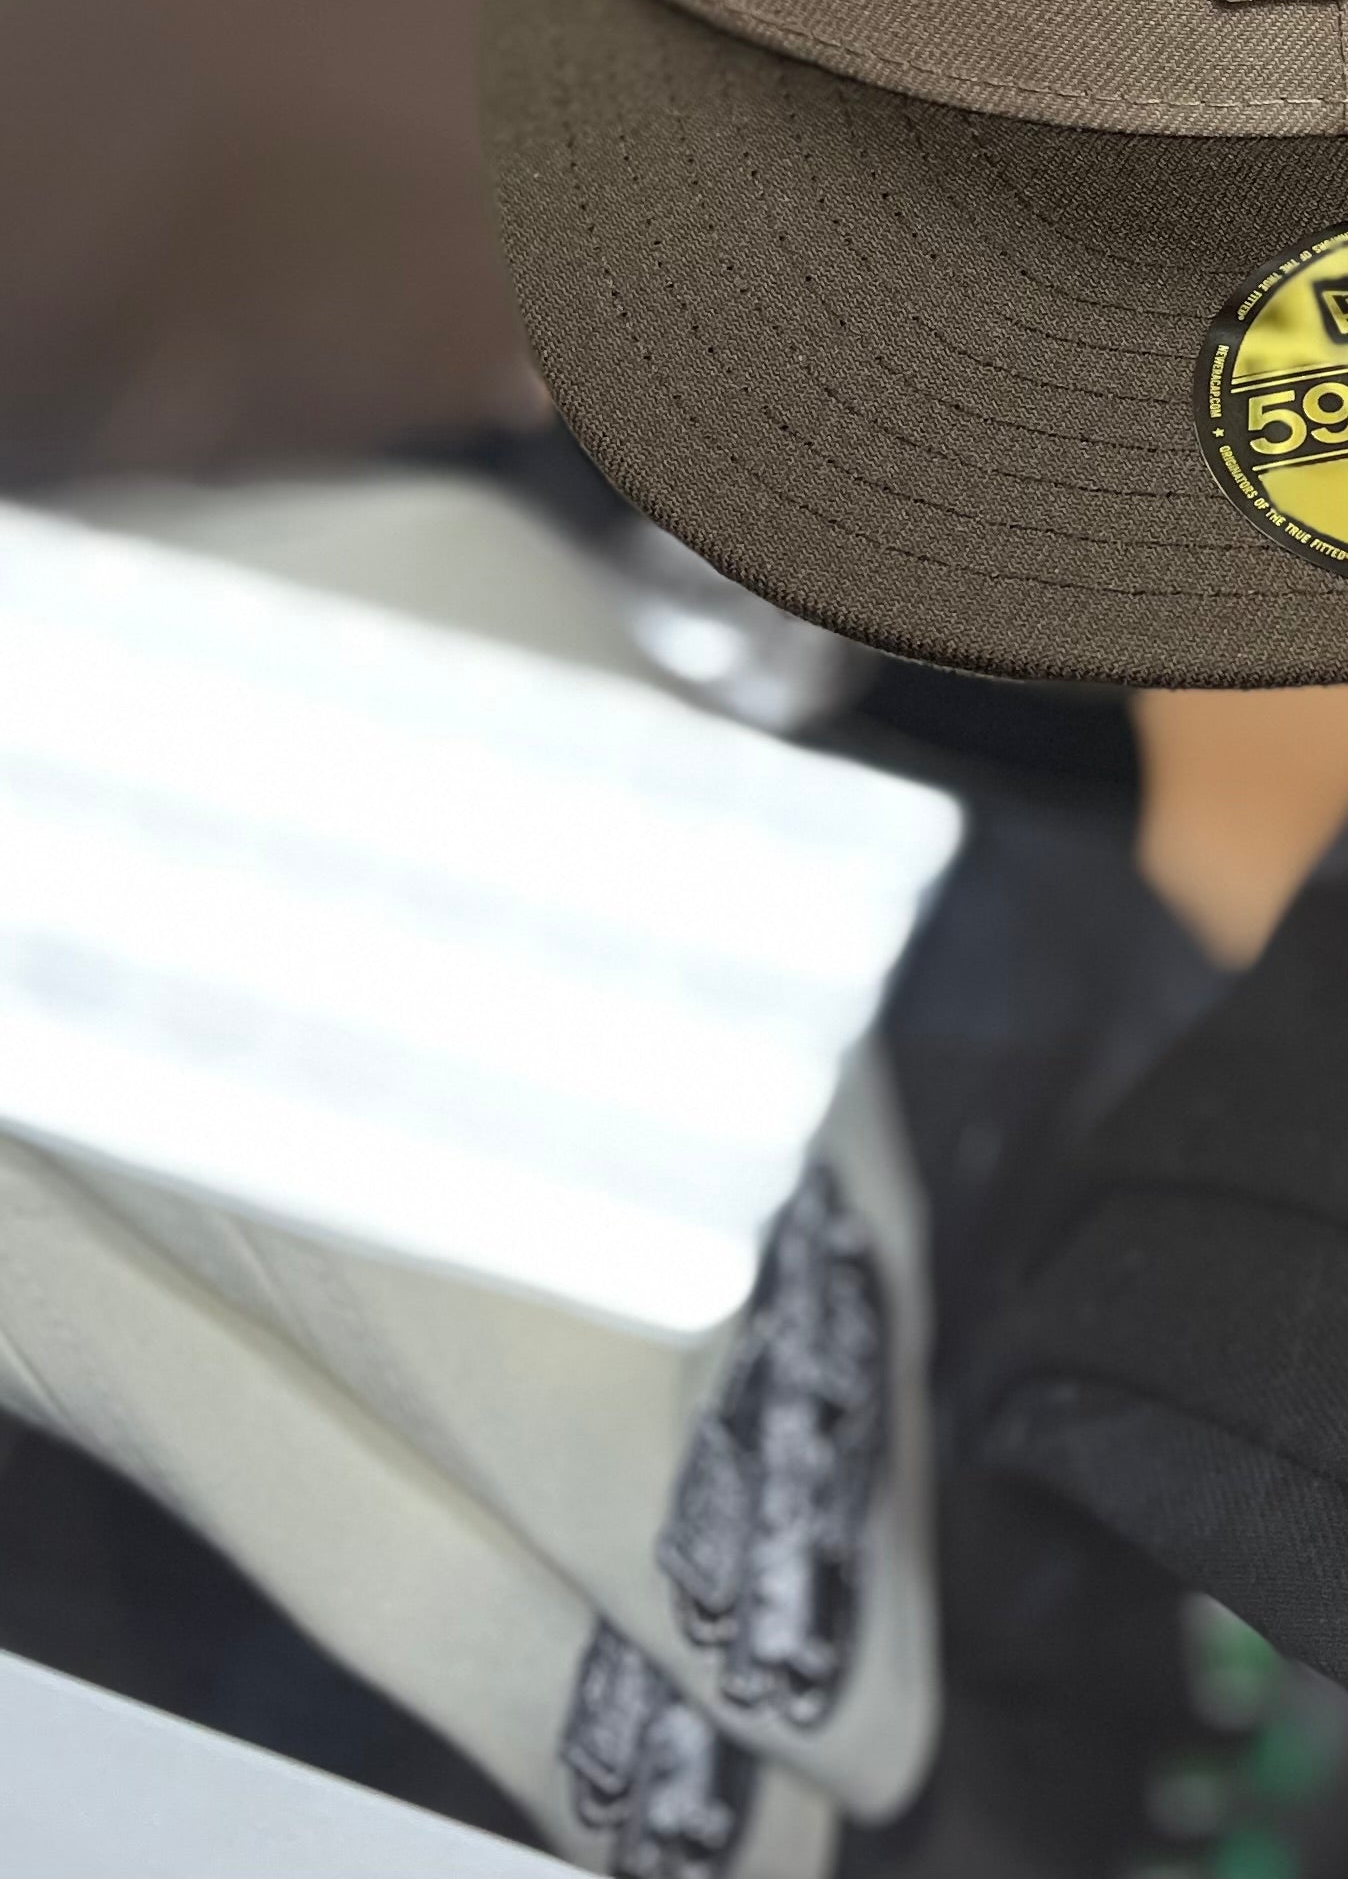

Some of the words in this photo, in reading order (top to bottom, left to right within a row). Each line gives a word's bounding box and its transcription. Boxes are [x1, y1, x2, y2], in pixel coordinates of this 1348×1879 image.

[1208, 344, 1230, 418] NEWERACAP.COM
[1218, 445, 1258, 499] ORIGINATORS
[1253, 497, 1270, 511] OF
[1265, 507, 1287, 527] THE
[1284, 522, 1313, 545] TRUE
